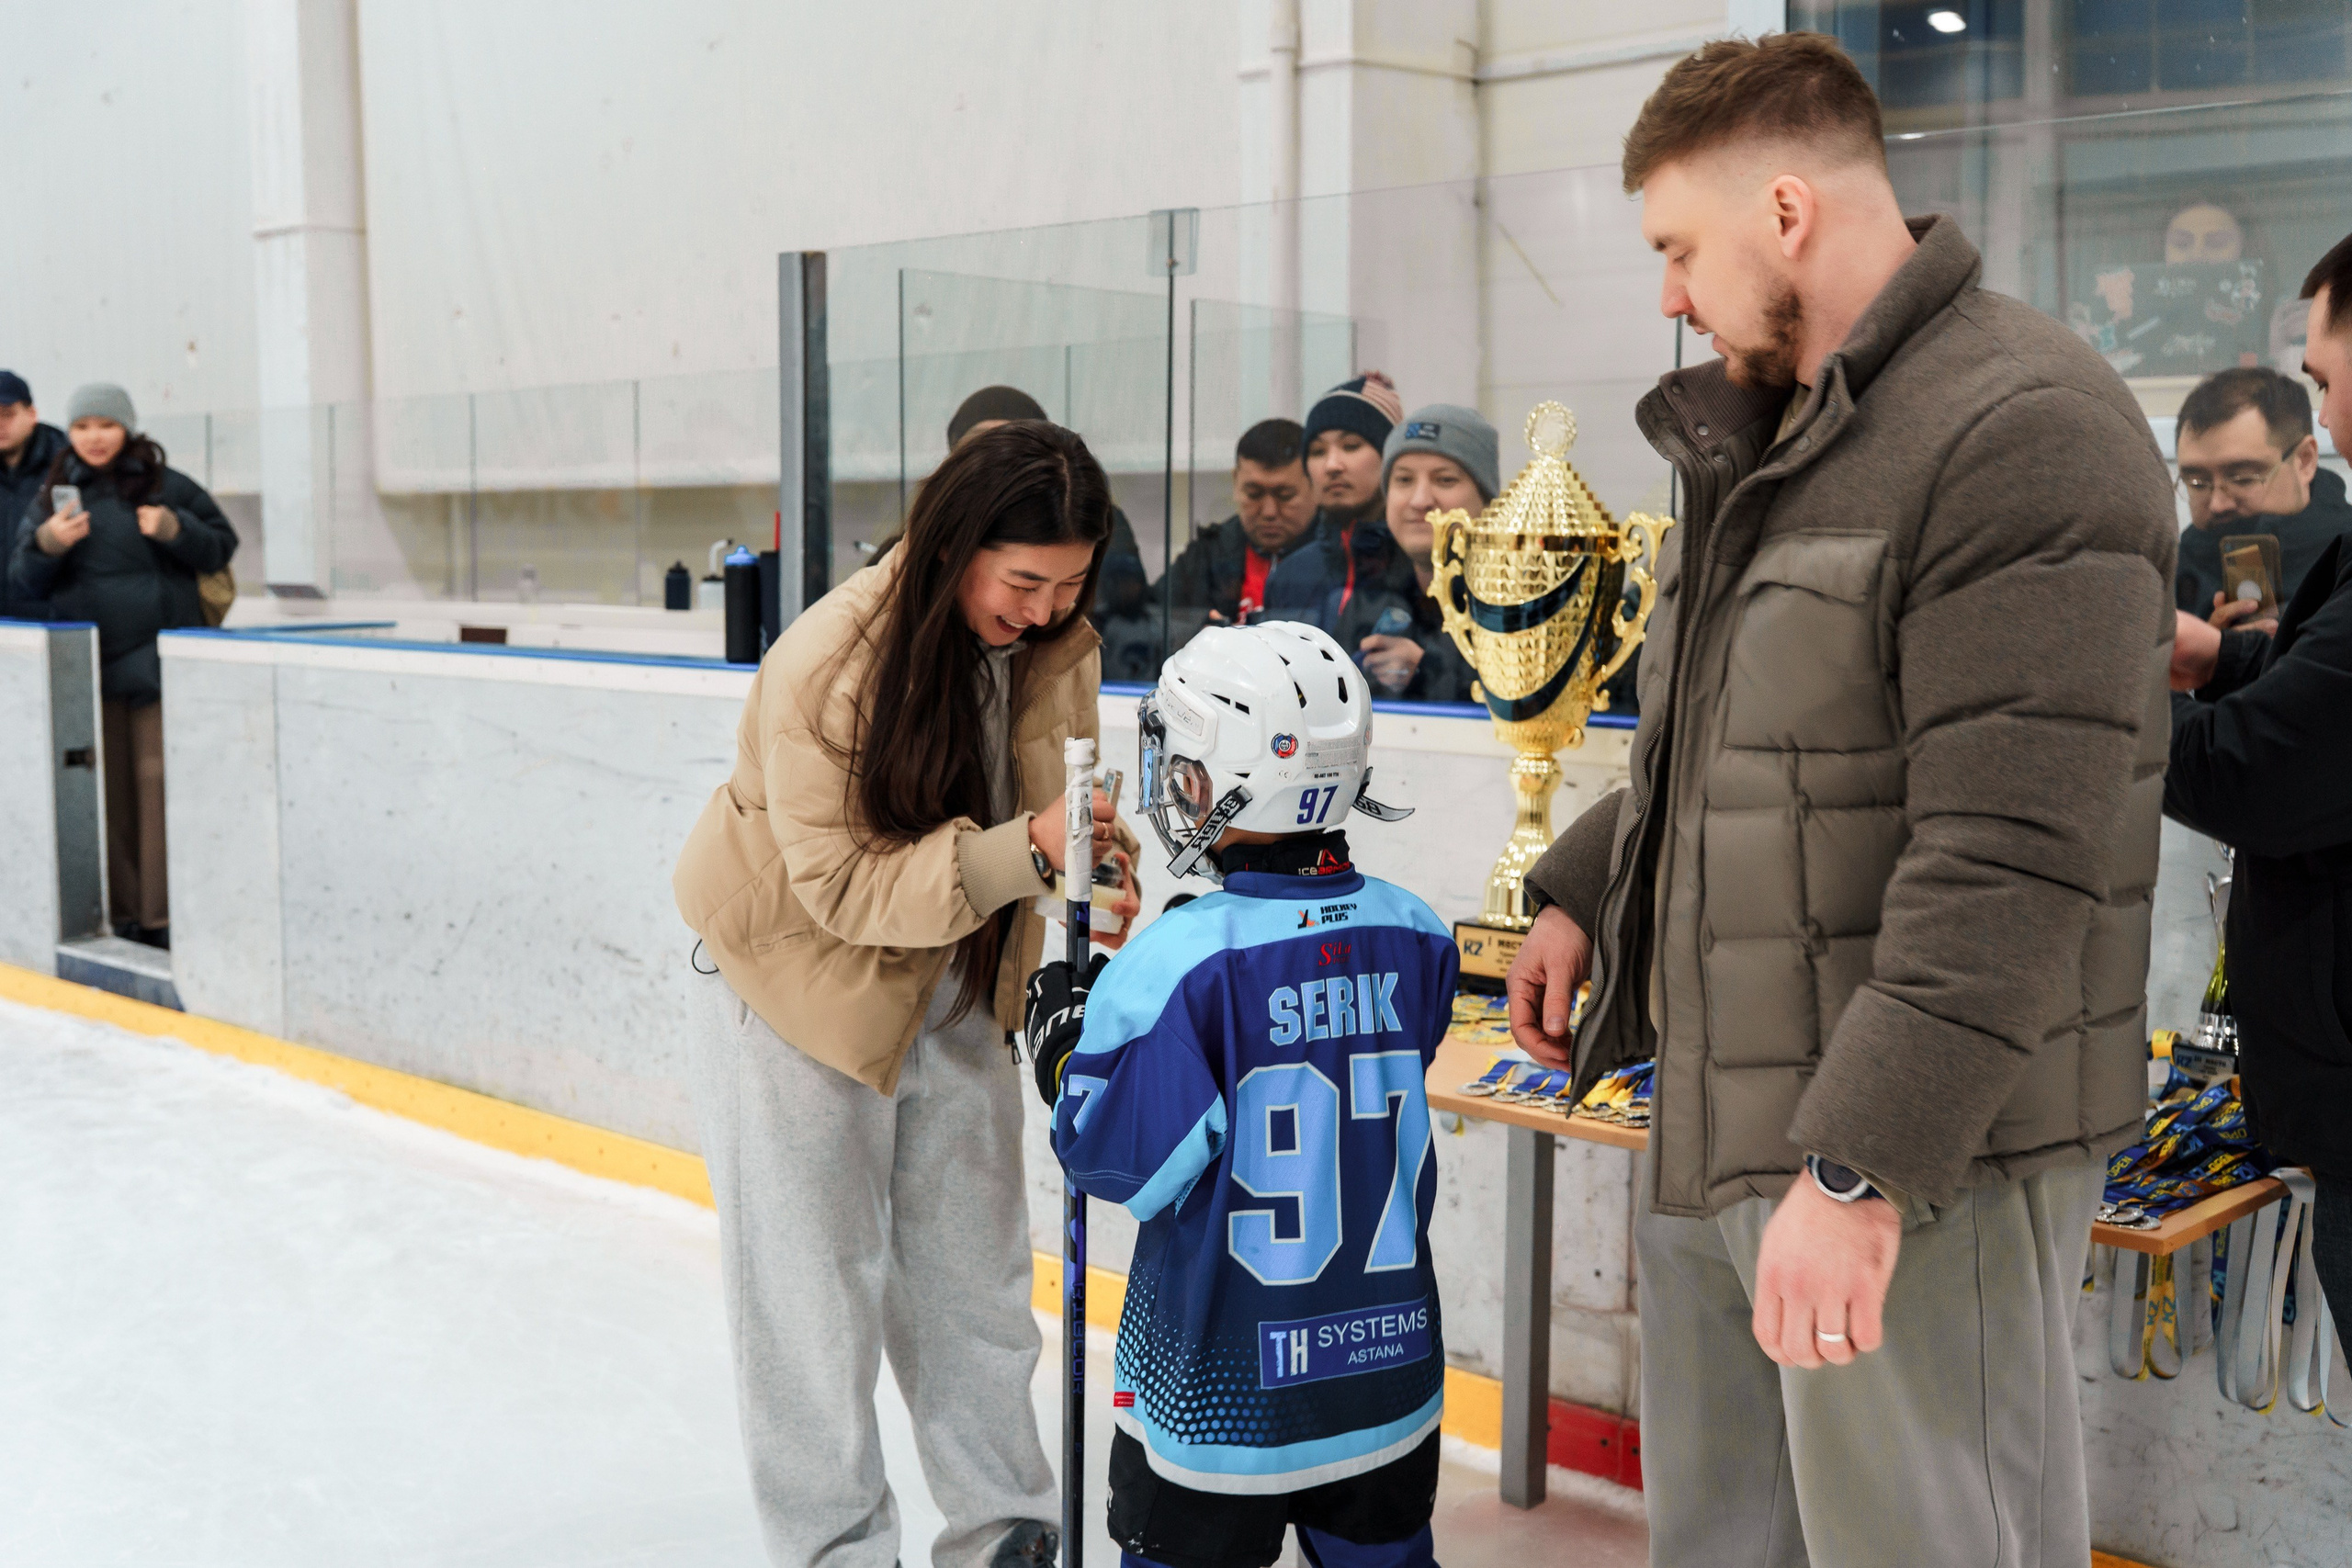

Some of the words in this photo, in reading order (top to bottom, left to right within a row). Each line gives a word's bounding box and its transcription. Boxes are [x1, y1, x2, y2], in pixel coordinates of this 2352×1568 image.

[1296, 784, 1339, 825] 97
[1320, 903, 1357, 916] HOCKEY
[1321, 911, 1349, 924] PLUS
[1268, 972, 1403, 1047] SERIK
[1228, 1049, 1432, 1286] 97
[1072, 1282, 1084, 1394] RIBCOR
[1270, 1328, 1308, 1378] TH
[1317, 1307, 1428, 1348] SYSTEMS
[1347, 1343, 1404, 1365] ASTANA
